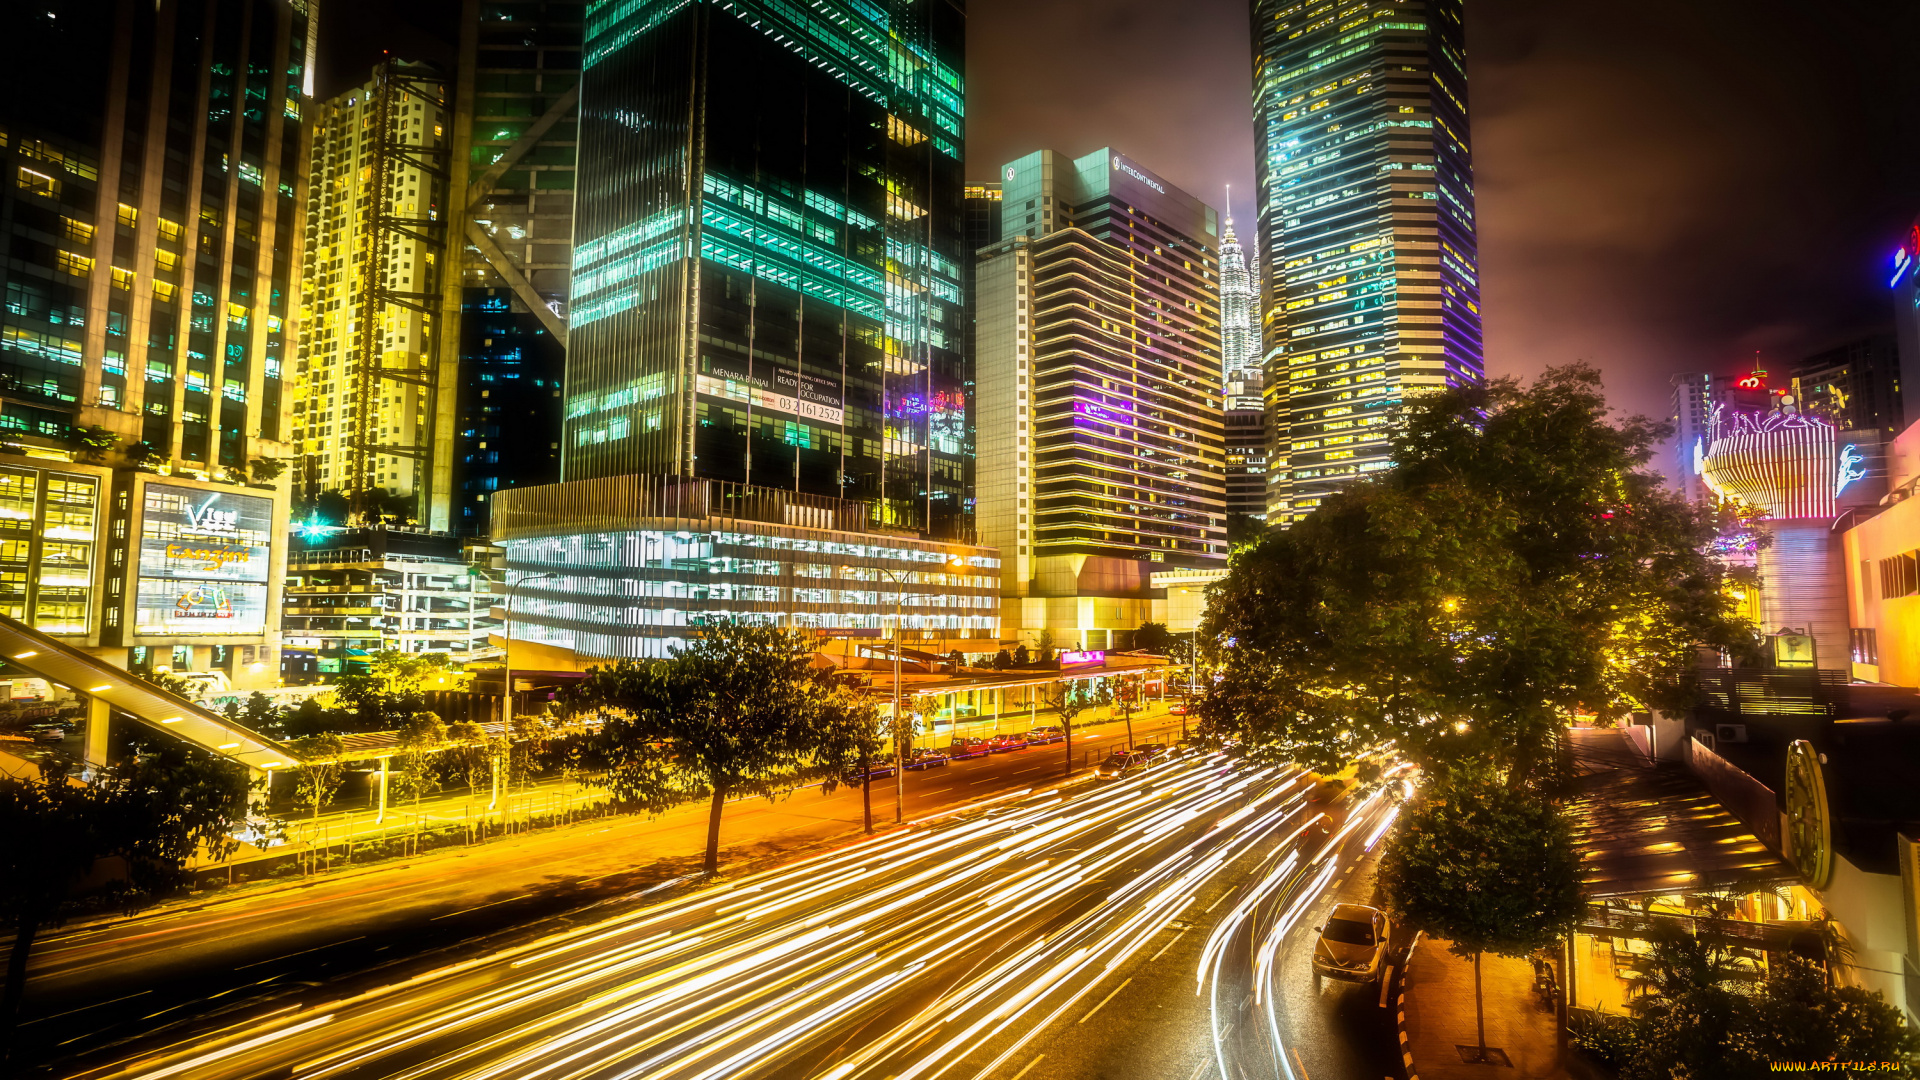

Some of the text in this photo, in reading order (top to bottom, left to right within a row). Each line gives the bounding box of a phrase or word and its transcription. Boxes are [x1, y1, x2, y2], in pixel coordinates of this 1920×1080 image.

[712, 367, 769, 388] MENARA BINJAI
[777, 375, 814, 391] READY FOR
[778, 368, 814, 382] AWARD-WNNING
[800, 390, 840, 406] OCCUPATION
[779, 397, 791, 410] 03
[819, 406, 840, 421] 2522
